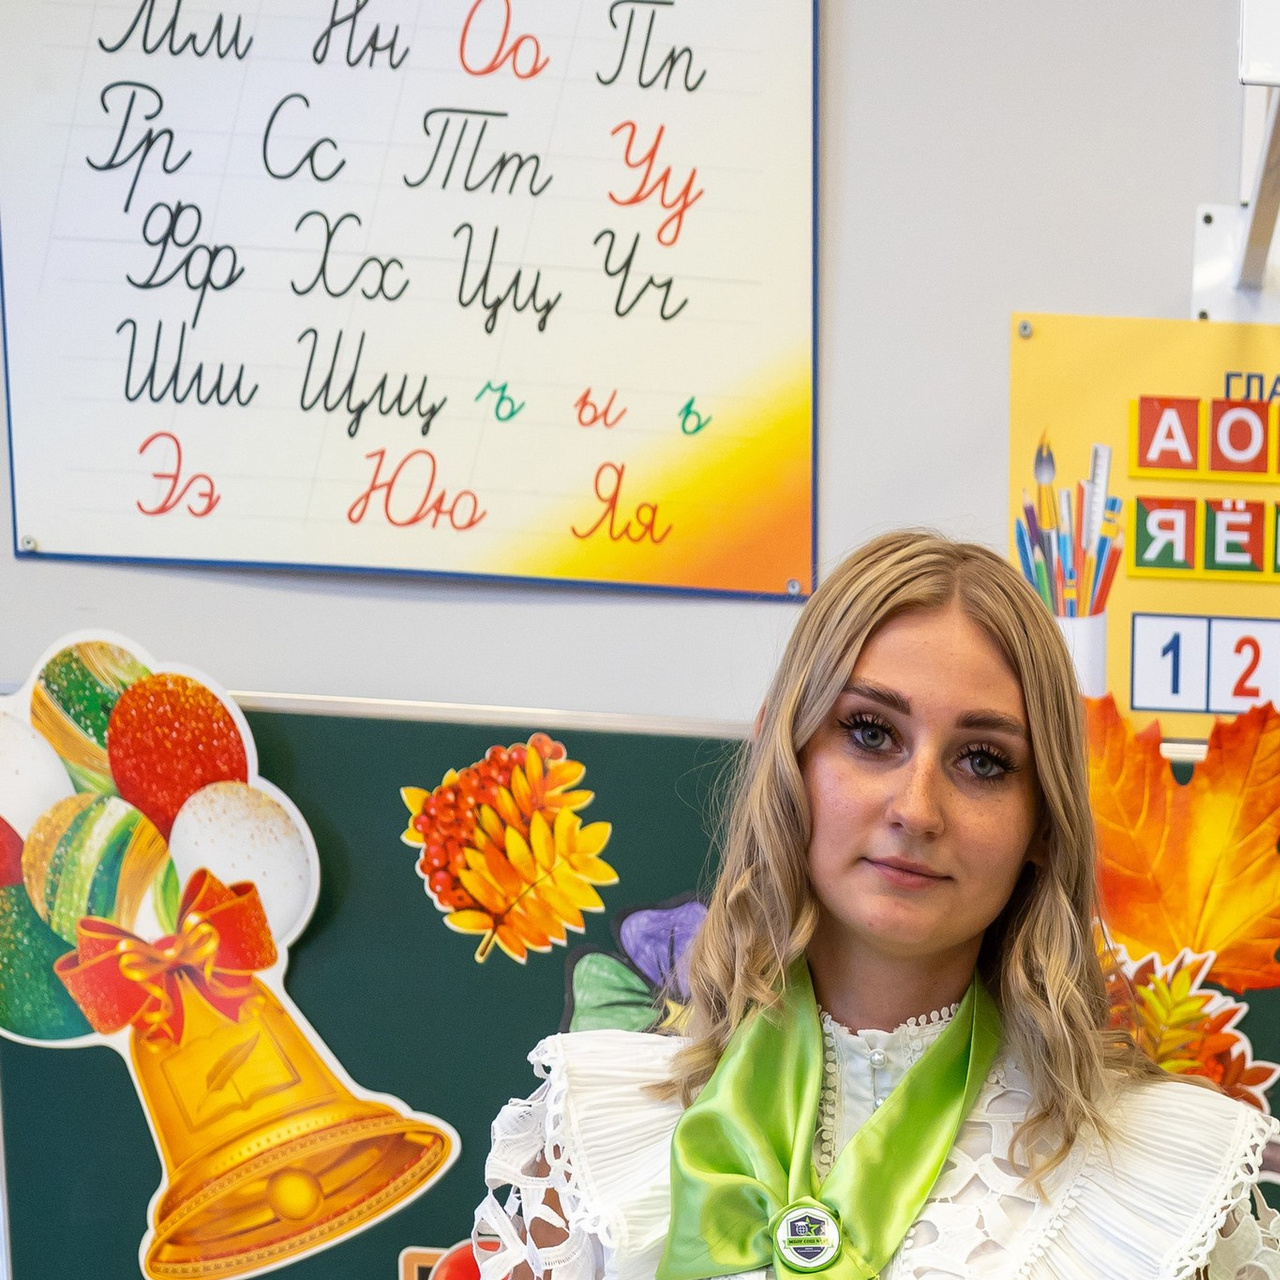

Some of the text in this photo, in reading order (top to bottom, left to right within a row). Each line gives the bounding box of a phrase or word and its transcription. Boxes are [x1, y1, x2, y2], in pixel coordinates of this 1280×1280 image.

[97, 0, 707, 92] Мм Нн Оо Пп
[86, 81, 705, 247] Рр Сс Тт Уу
[126, 200, 689, 334] Фф Хх Цц Чч
[116, 318, 713, 438] Шш Щщ ъ ы ь
[136, 431, 674, 546] Ээ Юю Яя
[1160, 633, 1181, 695] 1
[1233, 636, 1261, 698] 2
